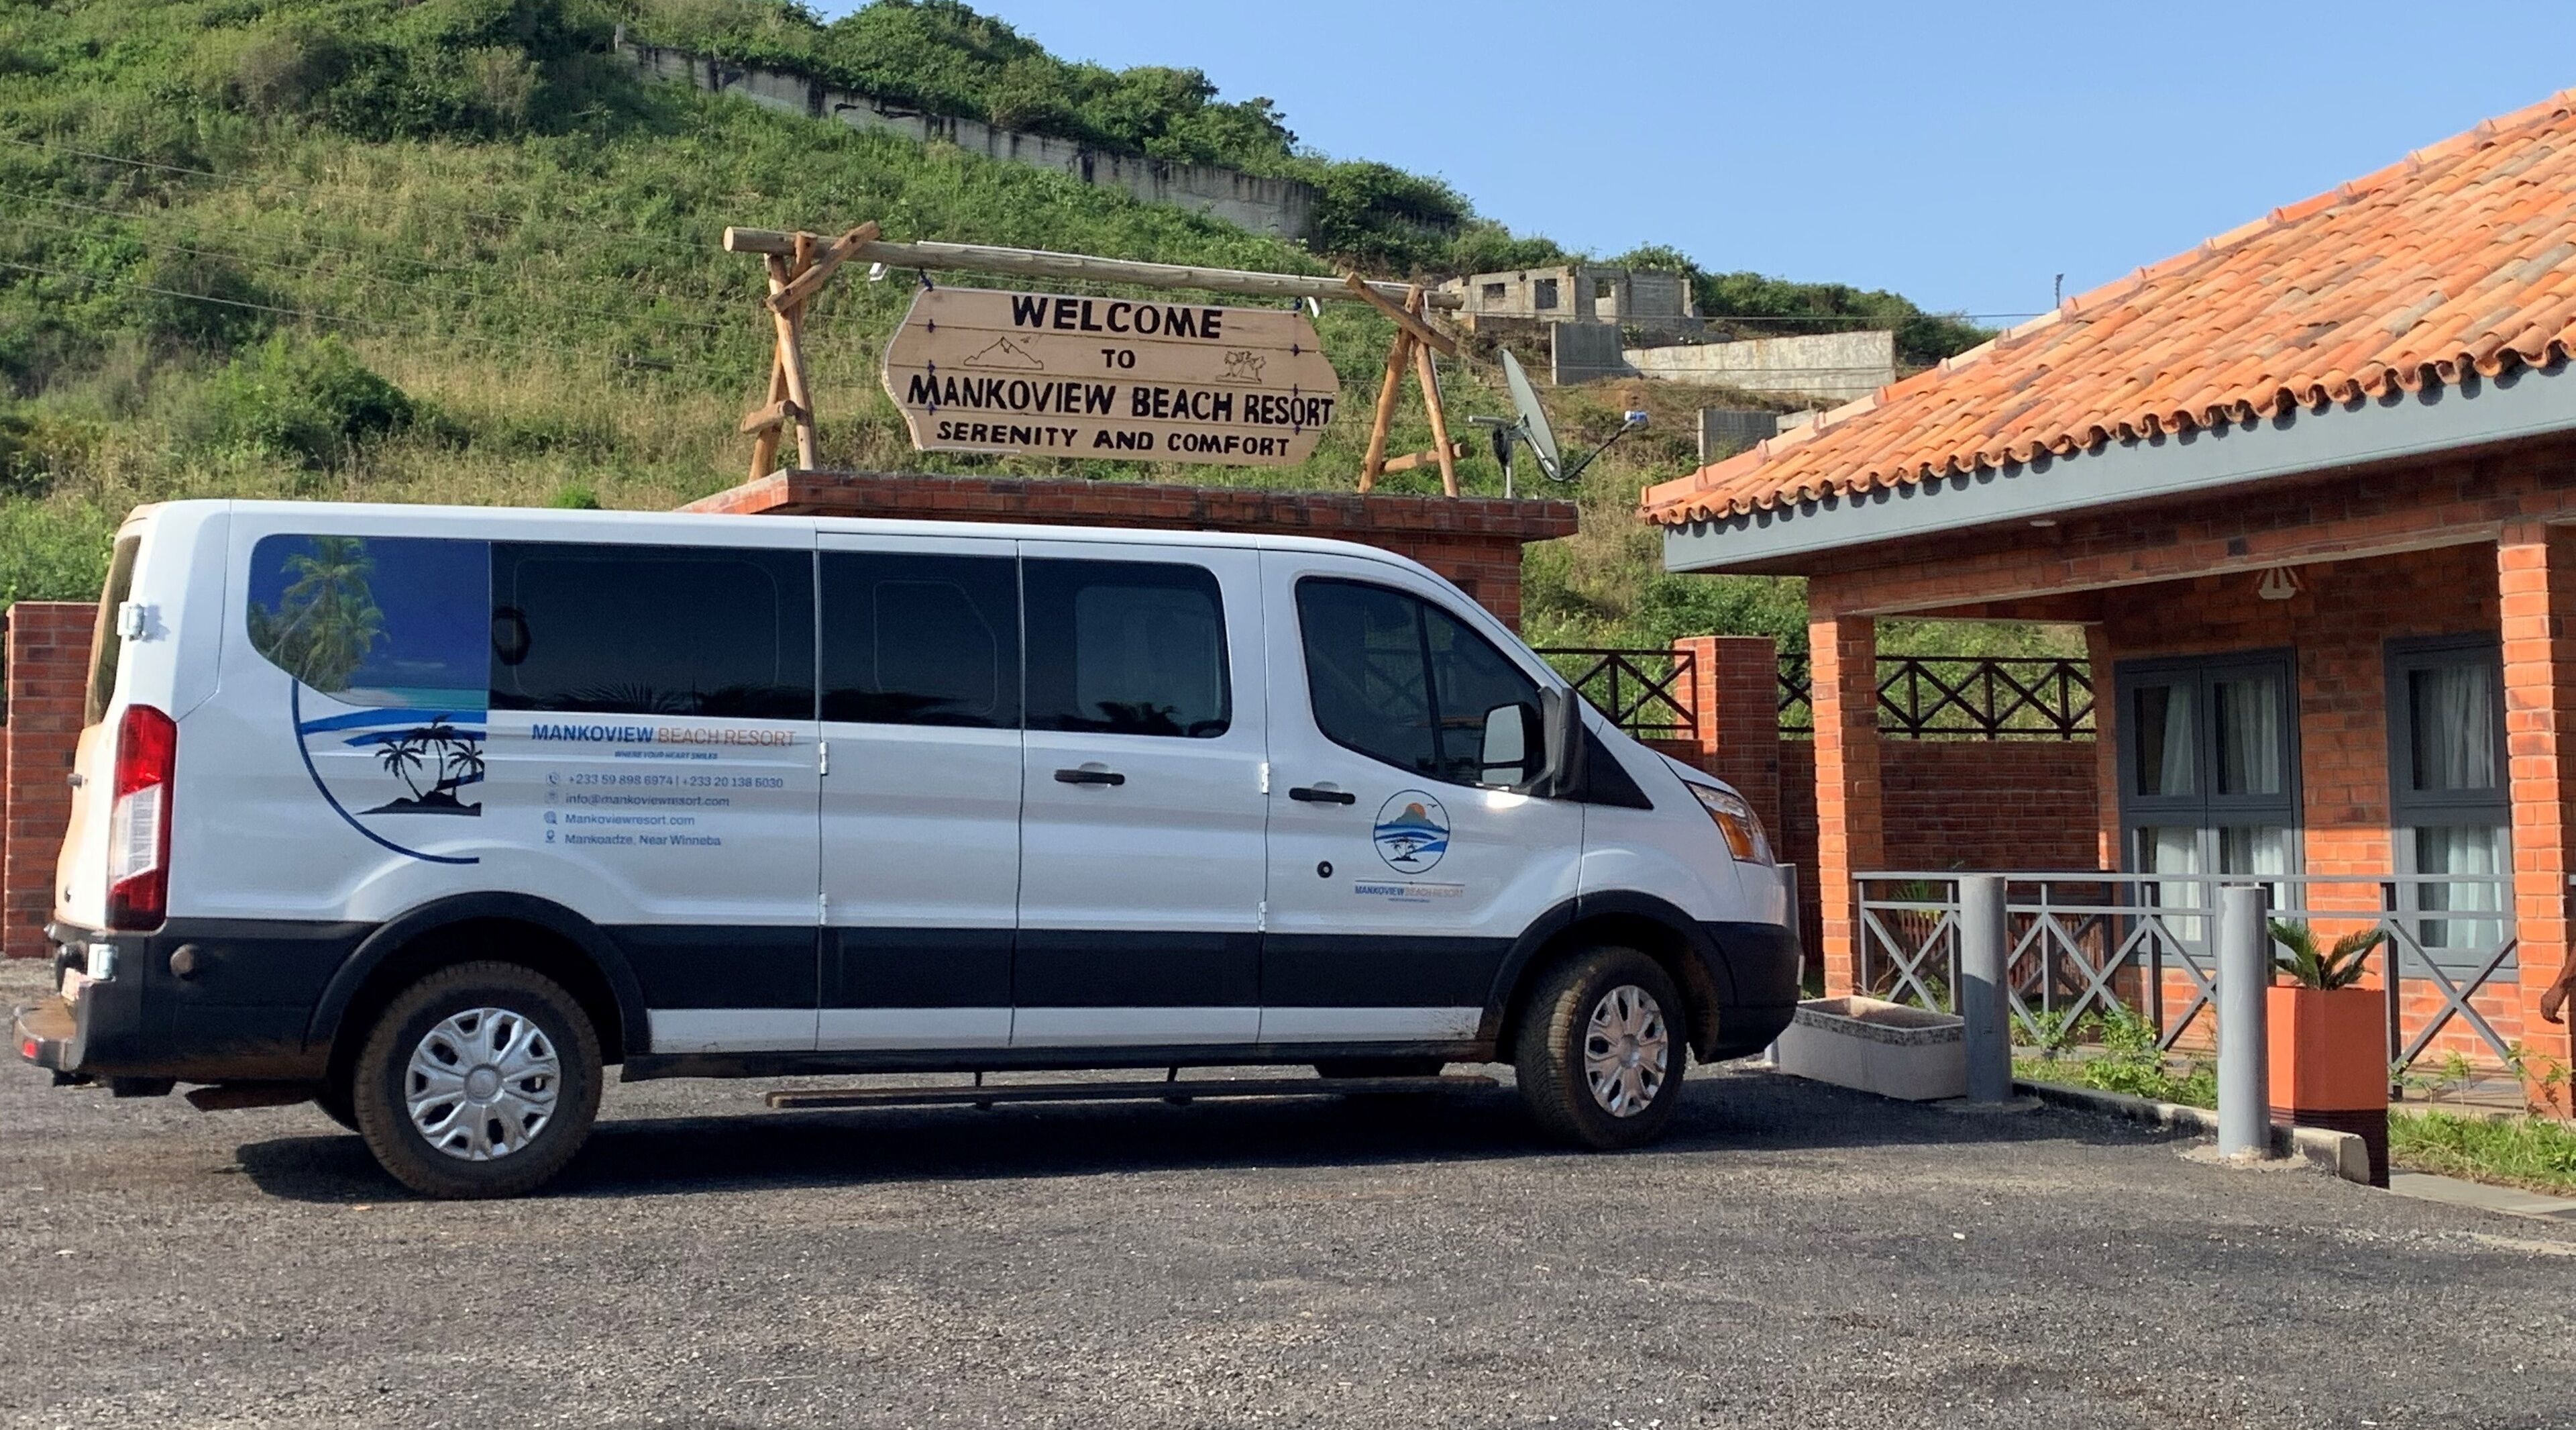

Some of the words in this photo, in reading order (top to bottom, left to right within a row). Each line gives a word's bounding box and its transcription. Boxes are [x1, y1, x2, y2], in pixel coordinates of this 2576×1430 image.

[1012, 295, 1223, 339] WELCOME
[1102, 349, 1136, 369] TO
[908, 374, 1116, 415] MANKOVIEW
[1132, 387, 1233, 422] BEACH
[1244, 394, 1334, 426] RESORT
[937, 421, 1078, 448] SERENITY
[1093, 429, 1154, 451] AND
[1167, 433, 1289, 456] COMFORT
[531, 724, 654, 743] MANKOVIEW
[657, 727, 720, 745] BEACH
[724, 729, 797, 747] RESORT
[570, 774, 598, 784] +233
[602, 774, 616, 785] 59
[683, 776, 712, 787] +233
[714, 776, 729, 787] 20
[565, 814, 695, 826] Mankoviewresort.com
[639, 835, 667, 846] Near
[669, 834, 722, 846] Winneba
[1355, 885, 1405, 896] MANKOVIEW
[1405, 887, 1432, 897] BEACH
[1433, 888, 1463, 898] RESORT
